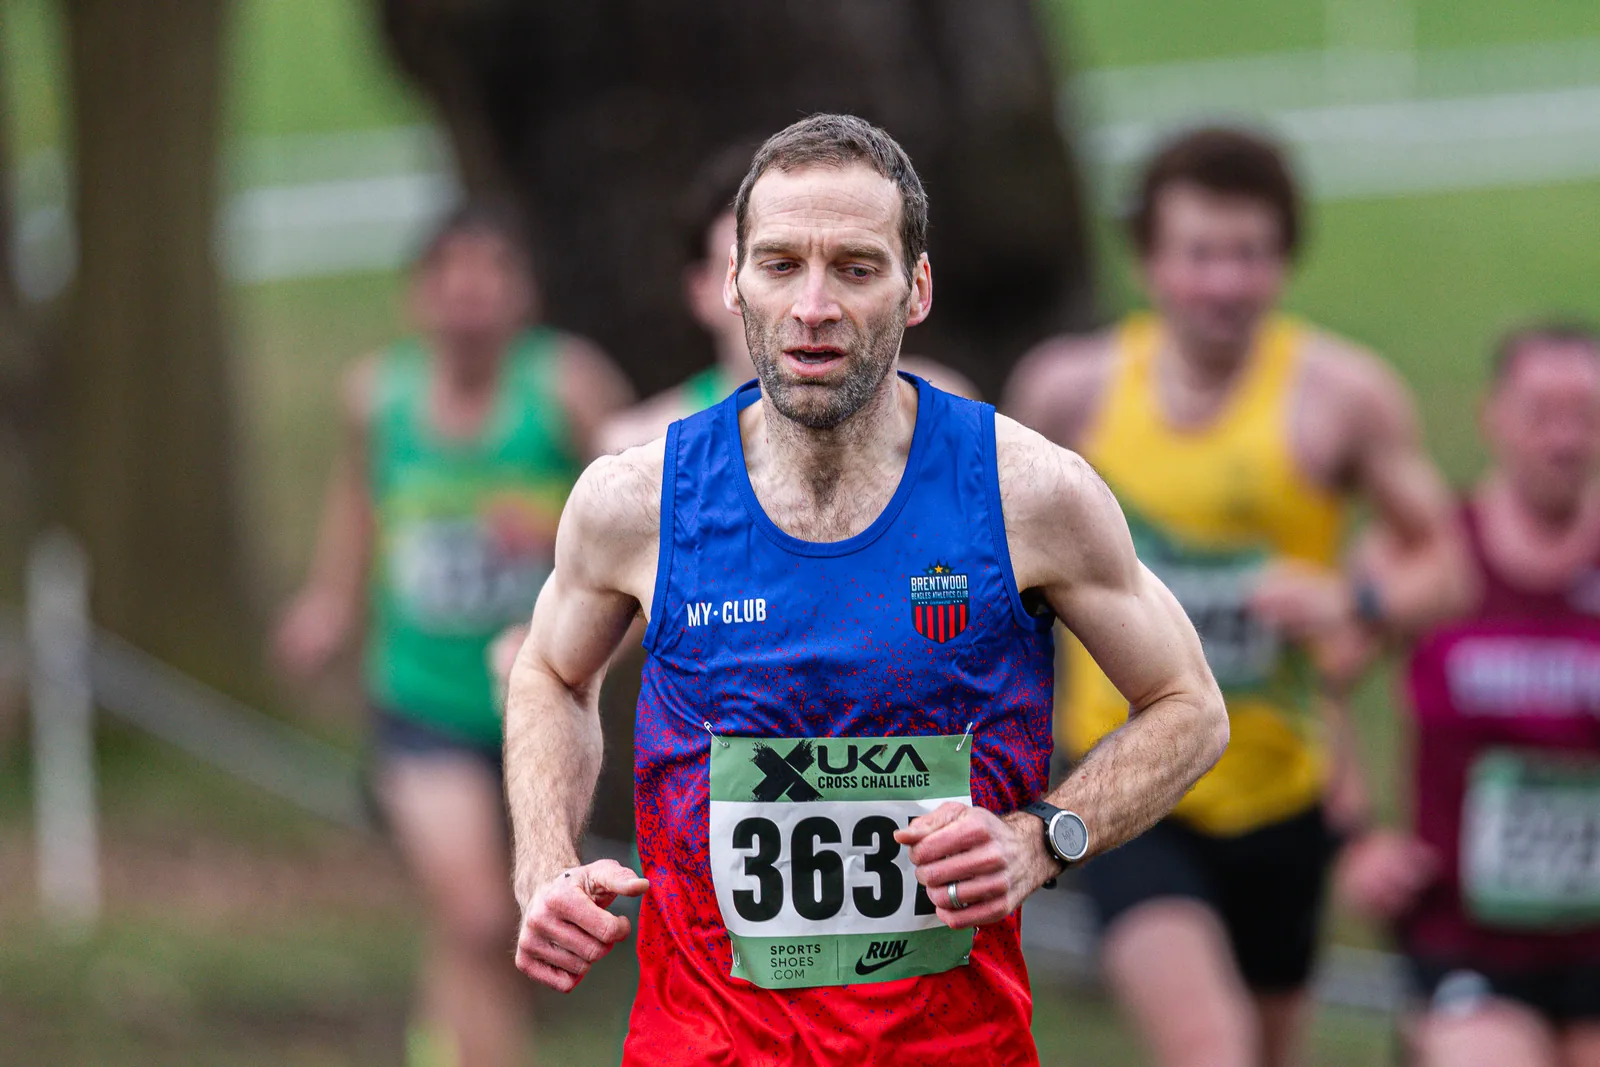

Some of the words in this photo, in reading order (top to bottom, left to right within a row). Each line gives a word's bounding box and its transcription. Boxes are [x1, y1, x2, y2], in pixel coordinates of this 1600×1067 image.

[911, 575, 968, 591] BRENTWOOD
[957, 590, 969, 598] CLUB
[817, 743, 930, 774] UKA
[817, 774, 858, 789] CROSS
[861, 773, 930, 788] CHALLENGE
[732, 815, 938, 922] 363
[770, 943, 821, 955] SPORTS
[866, 939, 909, 959] RUN
[770, 956, 814, 967] SHOES
[770, 969, 805, 980] .COM
